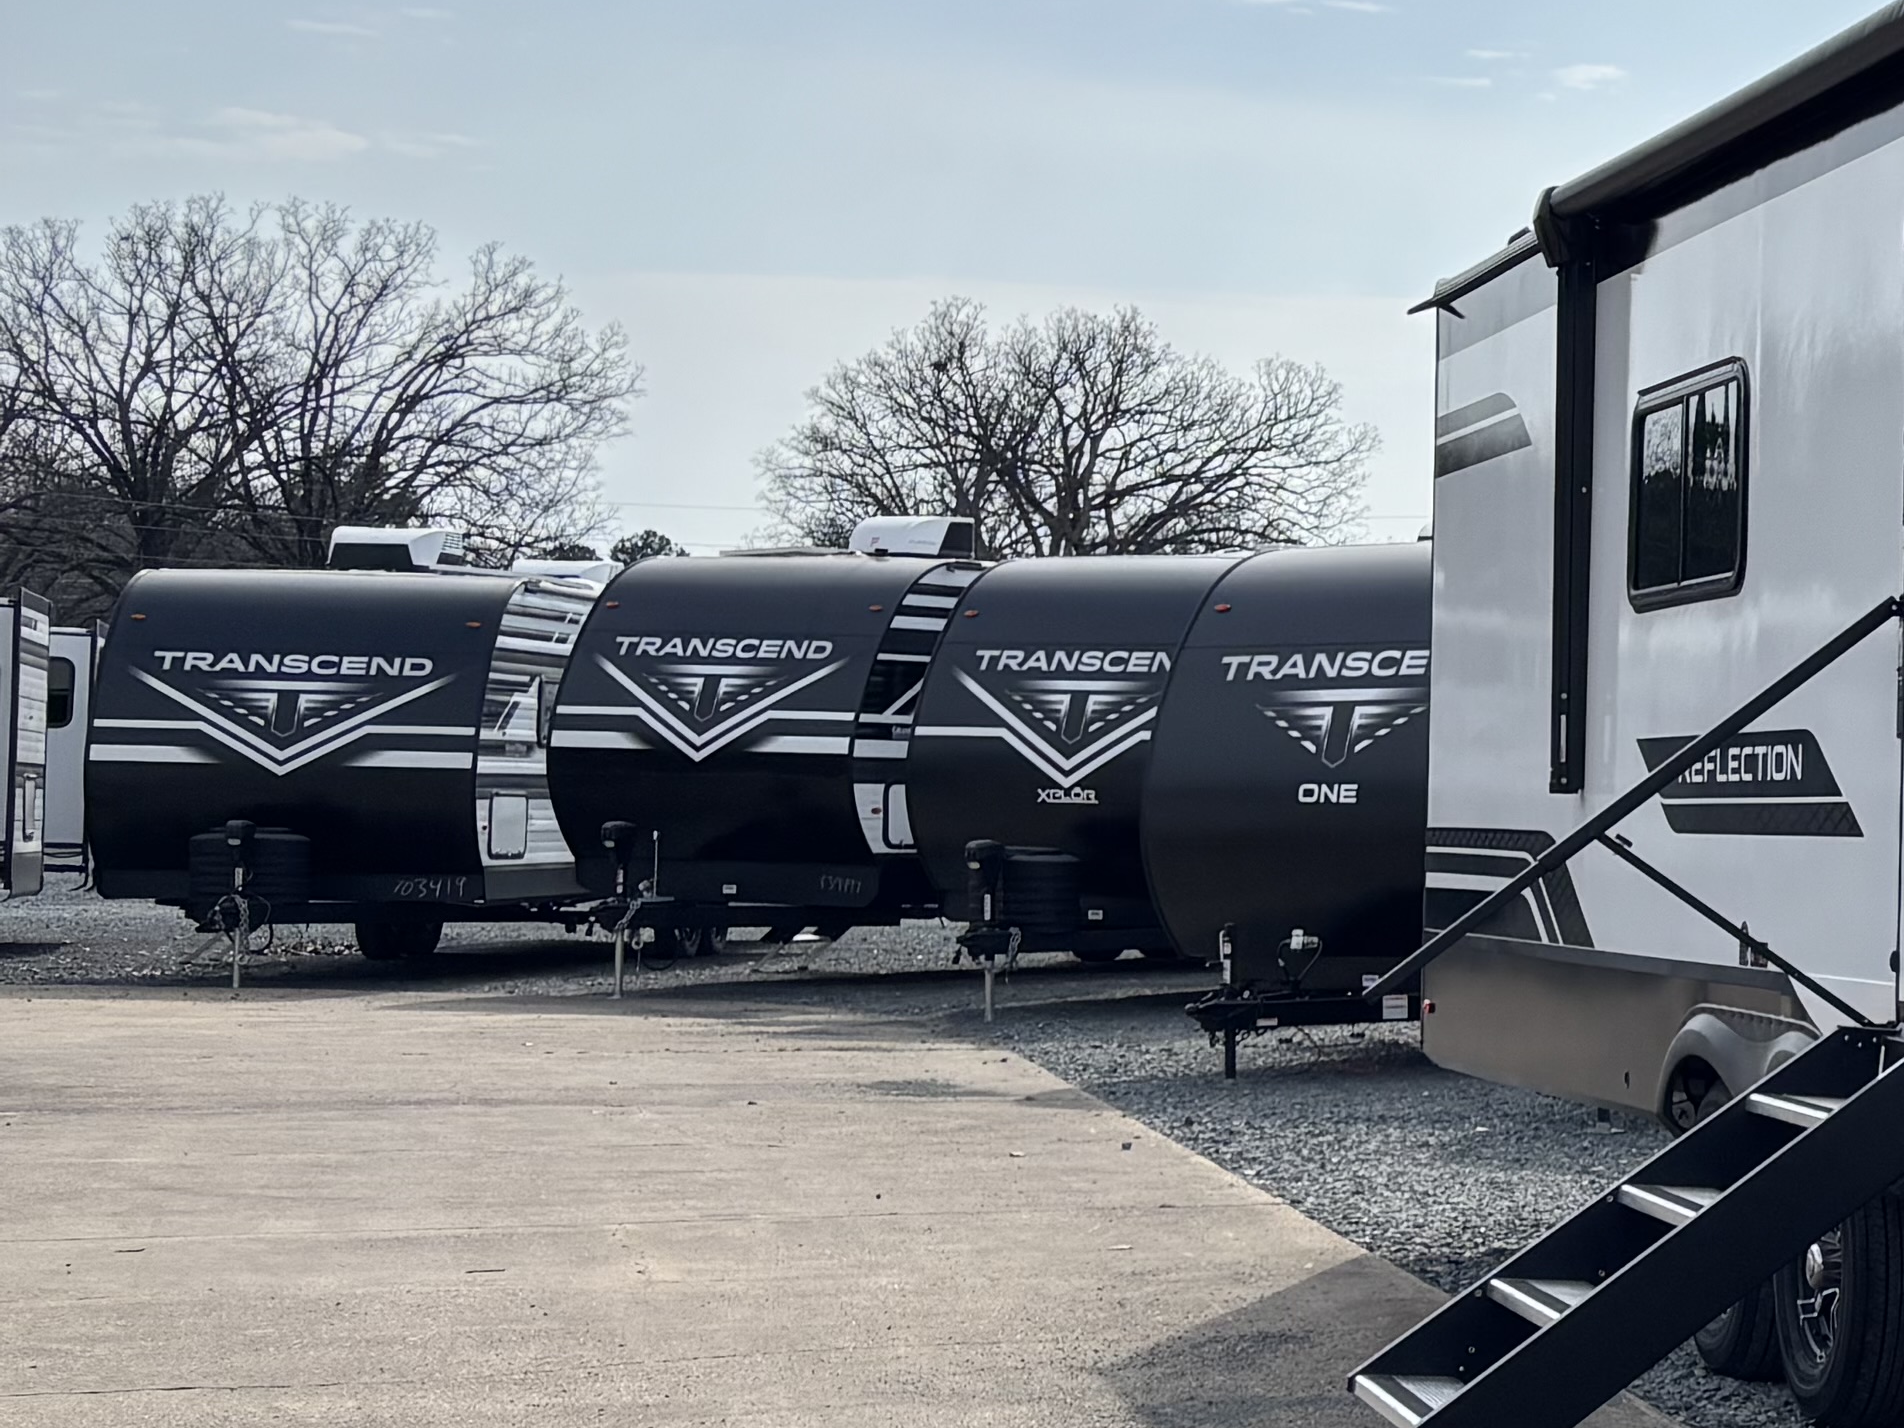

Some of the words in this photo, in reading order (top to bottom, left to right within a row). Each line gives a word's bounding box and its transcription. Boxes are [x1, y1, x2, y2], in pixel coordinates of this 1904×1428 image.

[615, 636, 833, 660] TRANSCEND
[153, 650, 434, 677] TRANSCEND
[975, 649, 1172, 673] TRANSCEN
[1221, 649, 1431, 681] TRANSCE
[1036, 786, 1099, 804] XPLOR
[1297, 783, 1359, 803] ONE
